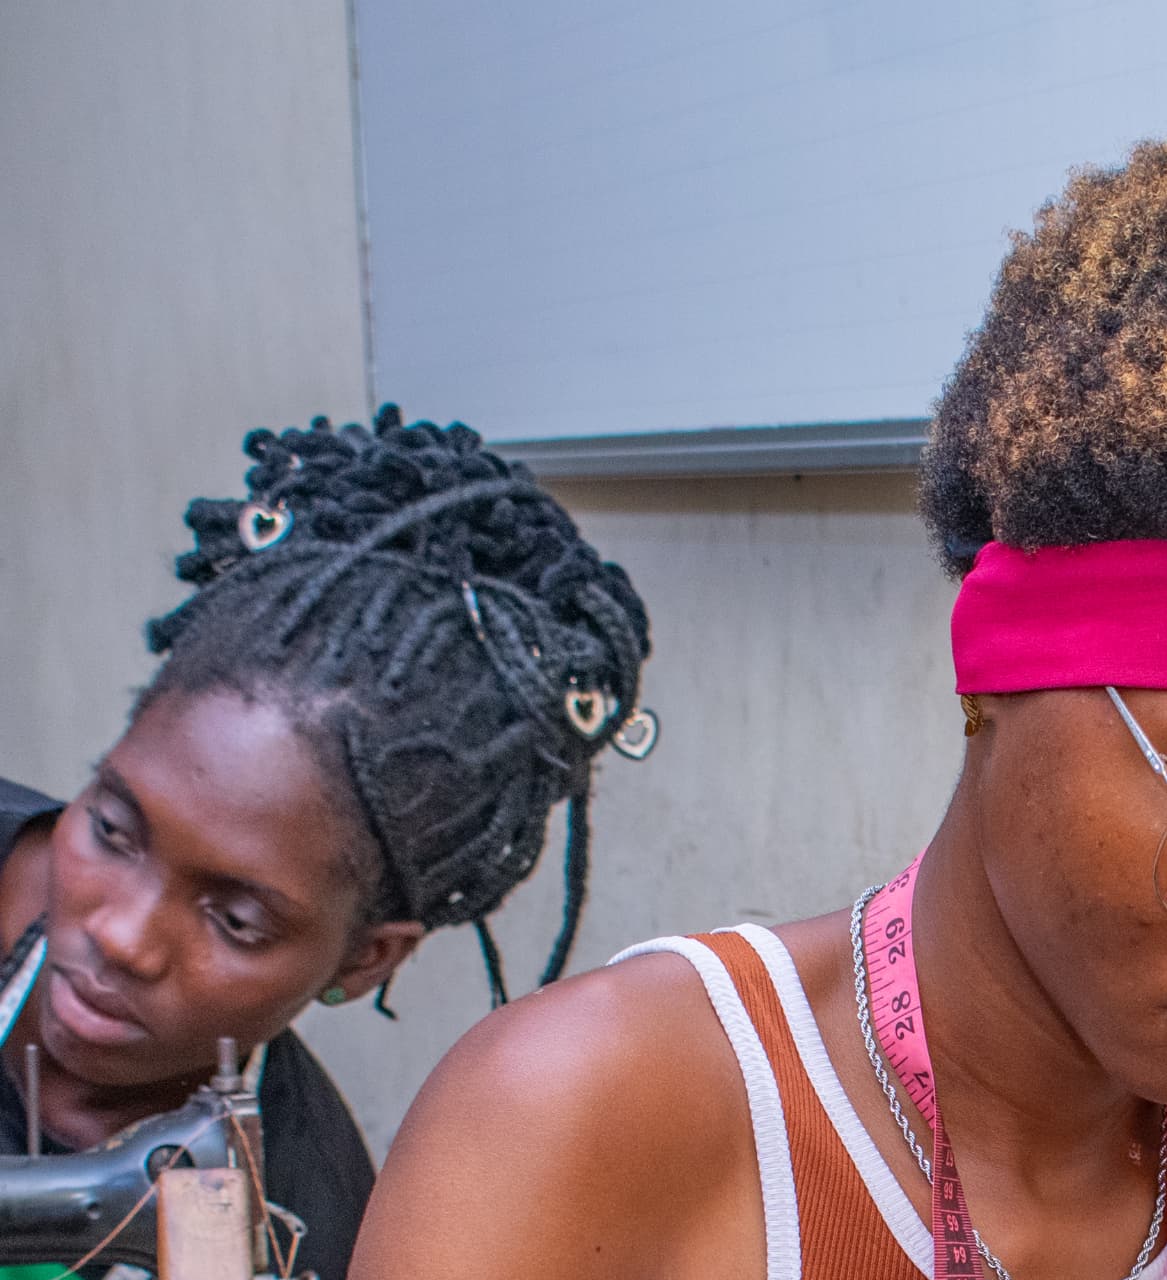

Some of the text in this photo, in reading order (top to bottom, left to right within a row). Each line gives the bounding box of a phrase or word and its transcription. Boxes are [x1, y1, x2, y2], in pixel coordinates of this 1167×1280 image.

[885, 917, 905, 965] 29
[891, 990, 915, 1040] 28
[943, 1181, 953, 1200] 66
[946, 1213, 959, 1232] 65
[953, 1246, 967, 1264] 64
